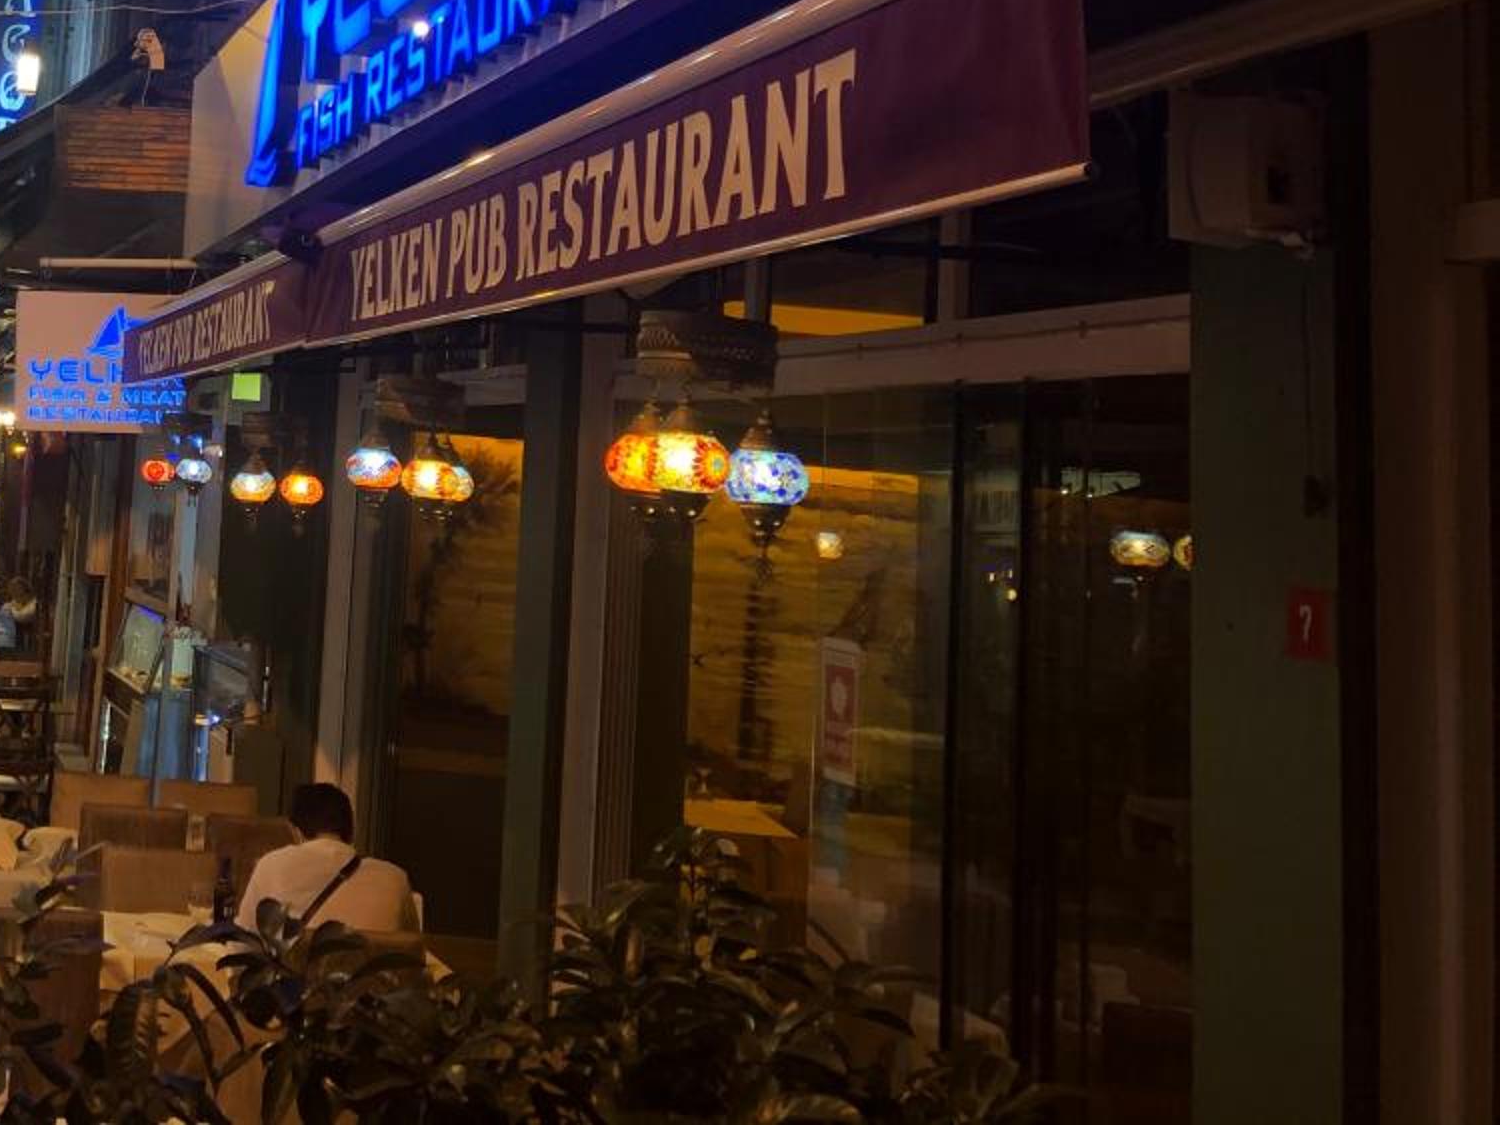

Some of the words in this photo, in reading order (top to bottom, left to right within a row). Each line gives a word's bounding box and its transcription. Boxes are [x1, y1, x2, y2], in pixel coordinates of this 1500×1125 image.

[295, 87, 354, 168] FISH
[350, 217, 444, 323] YELKEN
[446, 180, 508, 300] PUB
[515, 47, 858, 282] RESTAURANT
[28, 406, 165, 426] RESTAURAN
